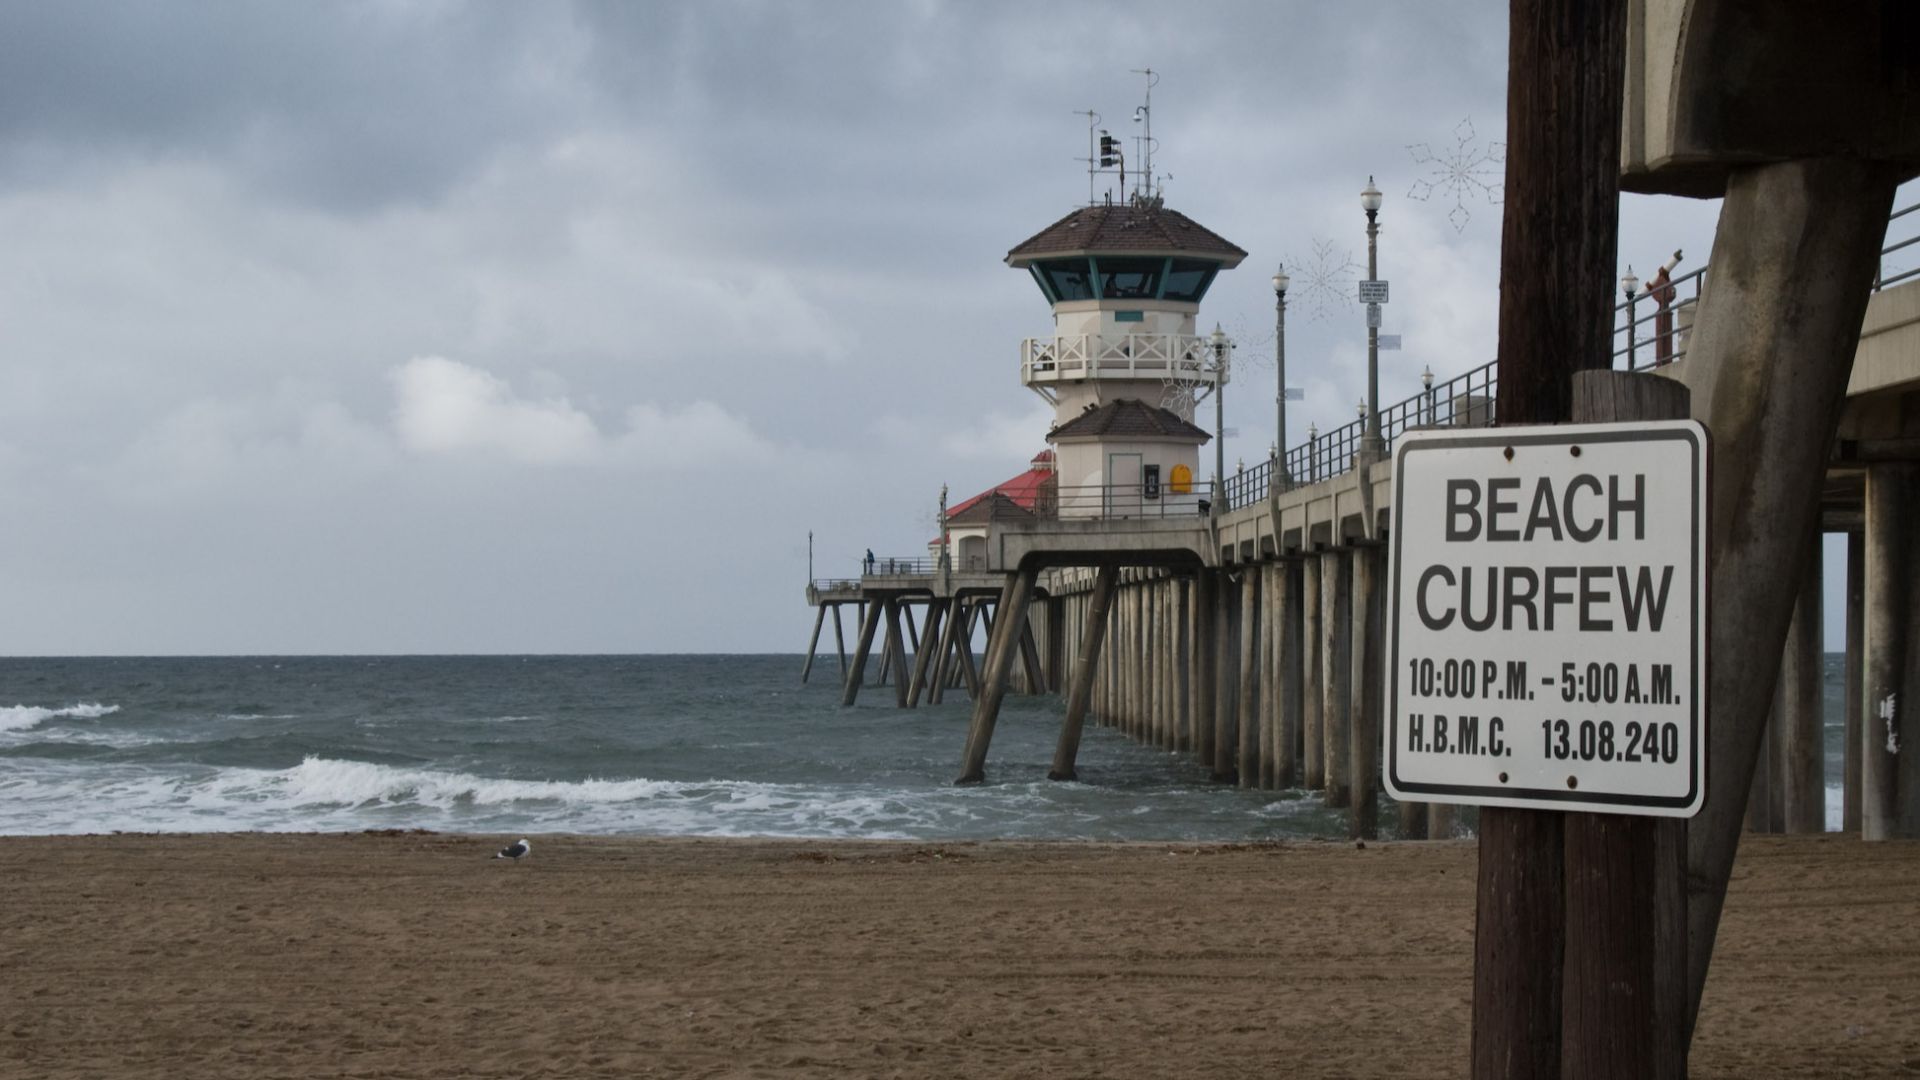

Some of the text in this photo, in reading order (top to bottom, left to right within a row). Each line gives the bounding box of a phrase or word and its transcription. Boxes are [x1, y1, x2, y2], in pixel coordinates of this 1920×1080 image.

[1445, 474, 1646, 543] BEACH
[1416, 564, 1675, 633] CURFEW
[1409, 657, 1476, 699] 10:00
[1624, 663, 1681, 706] A.M.
[1408, 713, 1679, 765] H.B.M.C. 13.08.240
